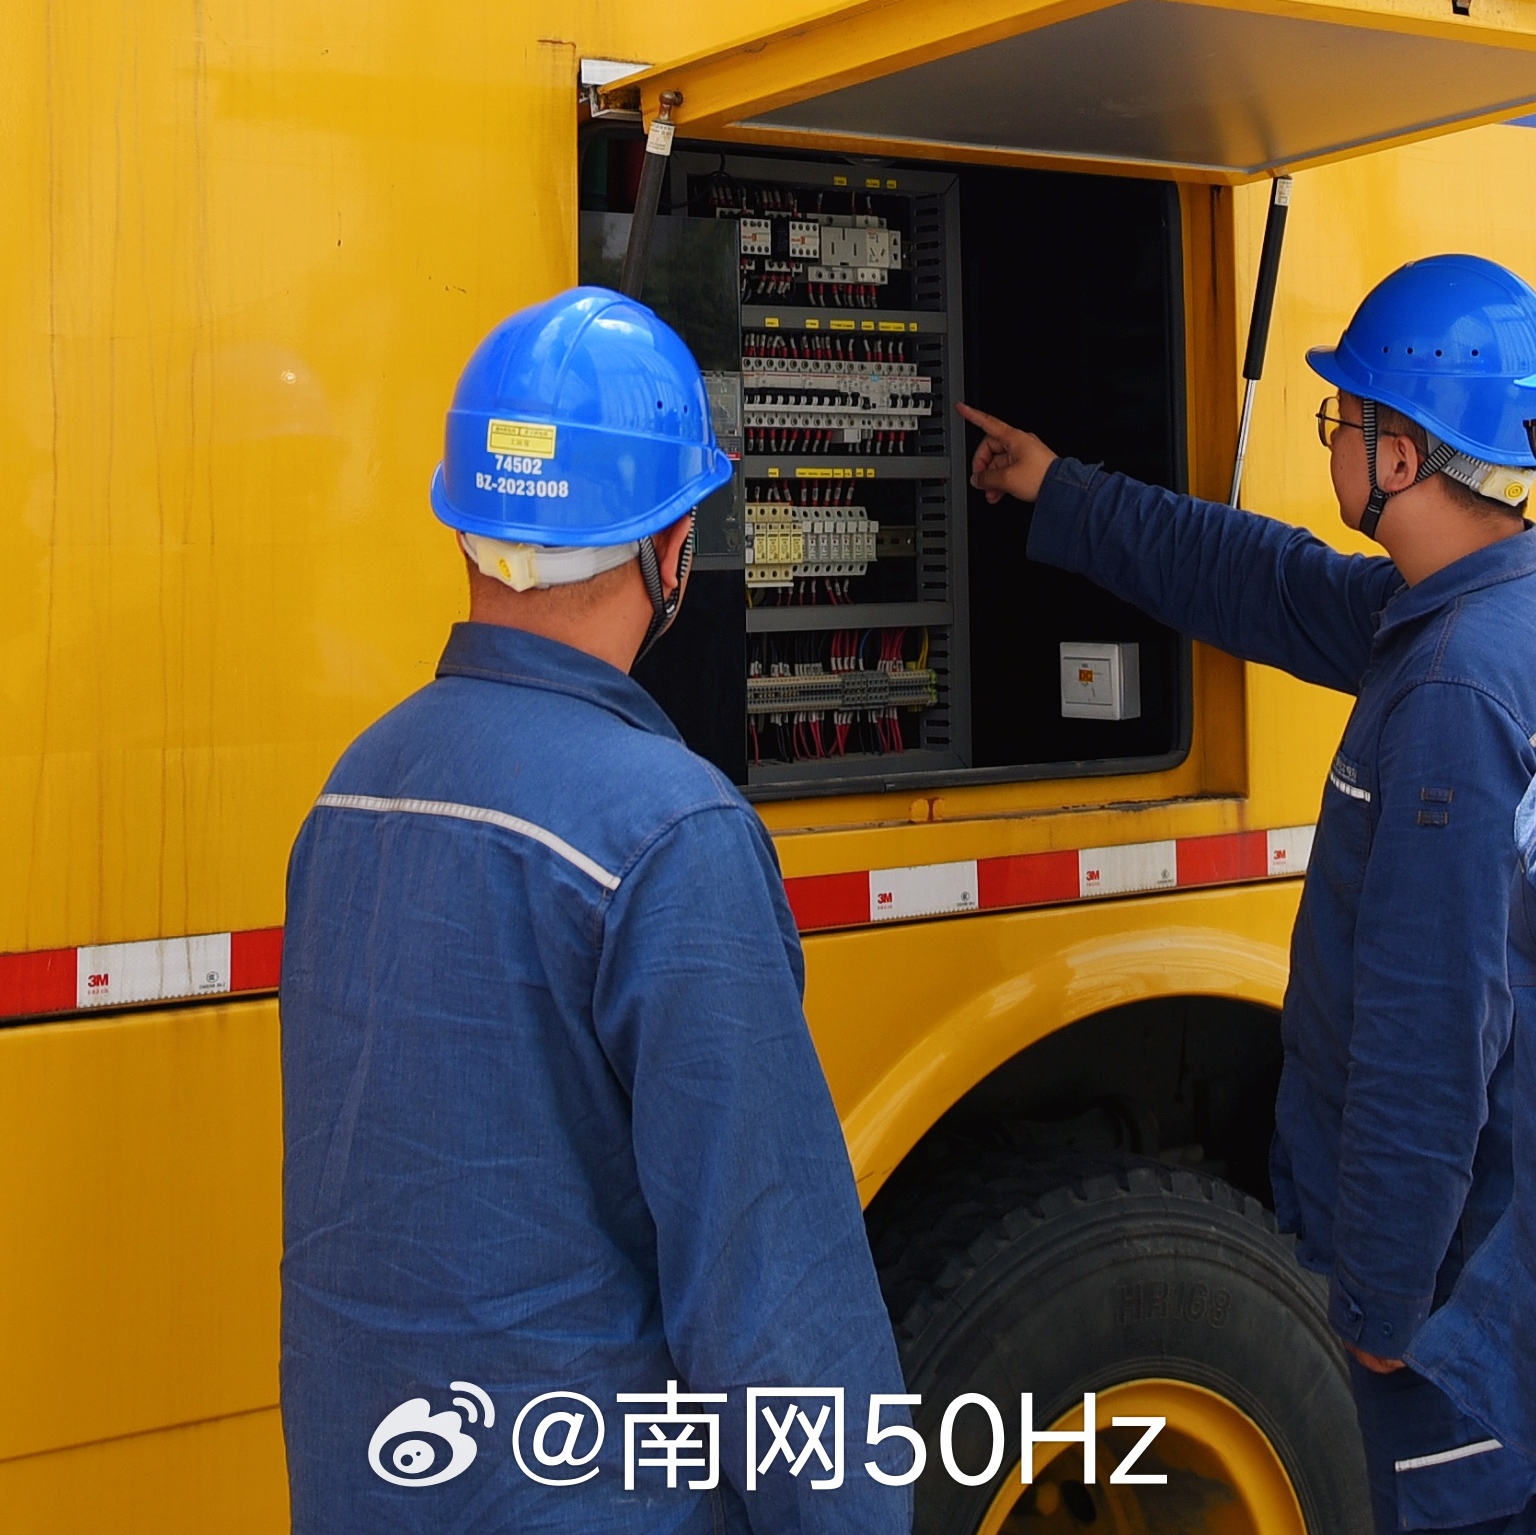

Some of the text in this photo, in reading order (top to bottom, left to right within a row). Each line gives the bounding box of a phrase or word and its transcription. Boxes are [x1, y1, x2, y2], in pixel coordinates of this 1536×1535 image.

[495, 455, 542, 475] 74502
[476, 472, 569, 498] BZ-2023008
[877, 892, 893, 904] 3M
[88, 973, 110, 989] 3M
[1114, 1280, 1232, 1329] HR168
